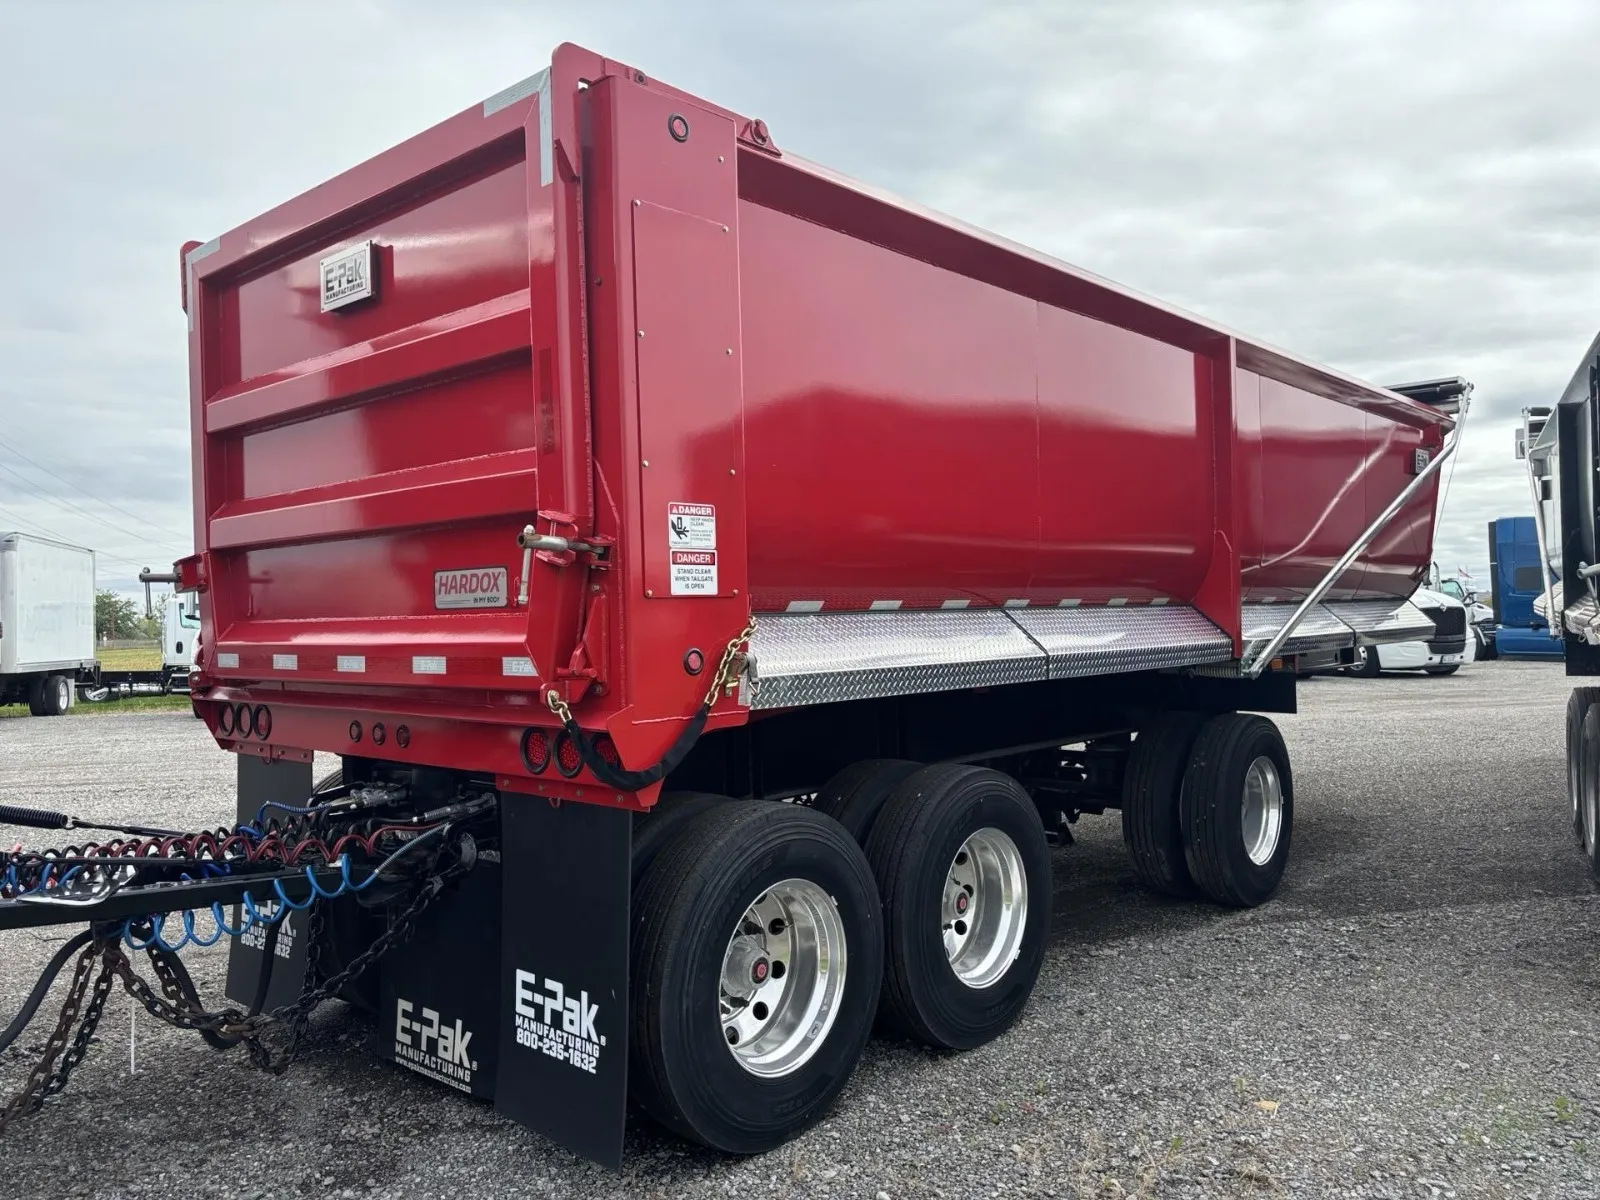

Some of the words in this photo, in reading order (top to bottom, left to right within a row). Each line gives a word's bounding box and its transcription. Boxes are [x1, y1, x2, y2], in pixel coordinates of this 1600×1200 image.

[326, 281, 363, 300] MANUFACTURING
[678, 505, 712, 516] DANGER
[676, 553, 711, 563] DANGER
[515, 1013, 600, 1058] MANUFACTURING
[516, 1027, 597, 1074] 800-235-1632
[395, 1041, 471, 1083] MANUFACTURING
